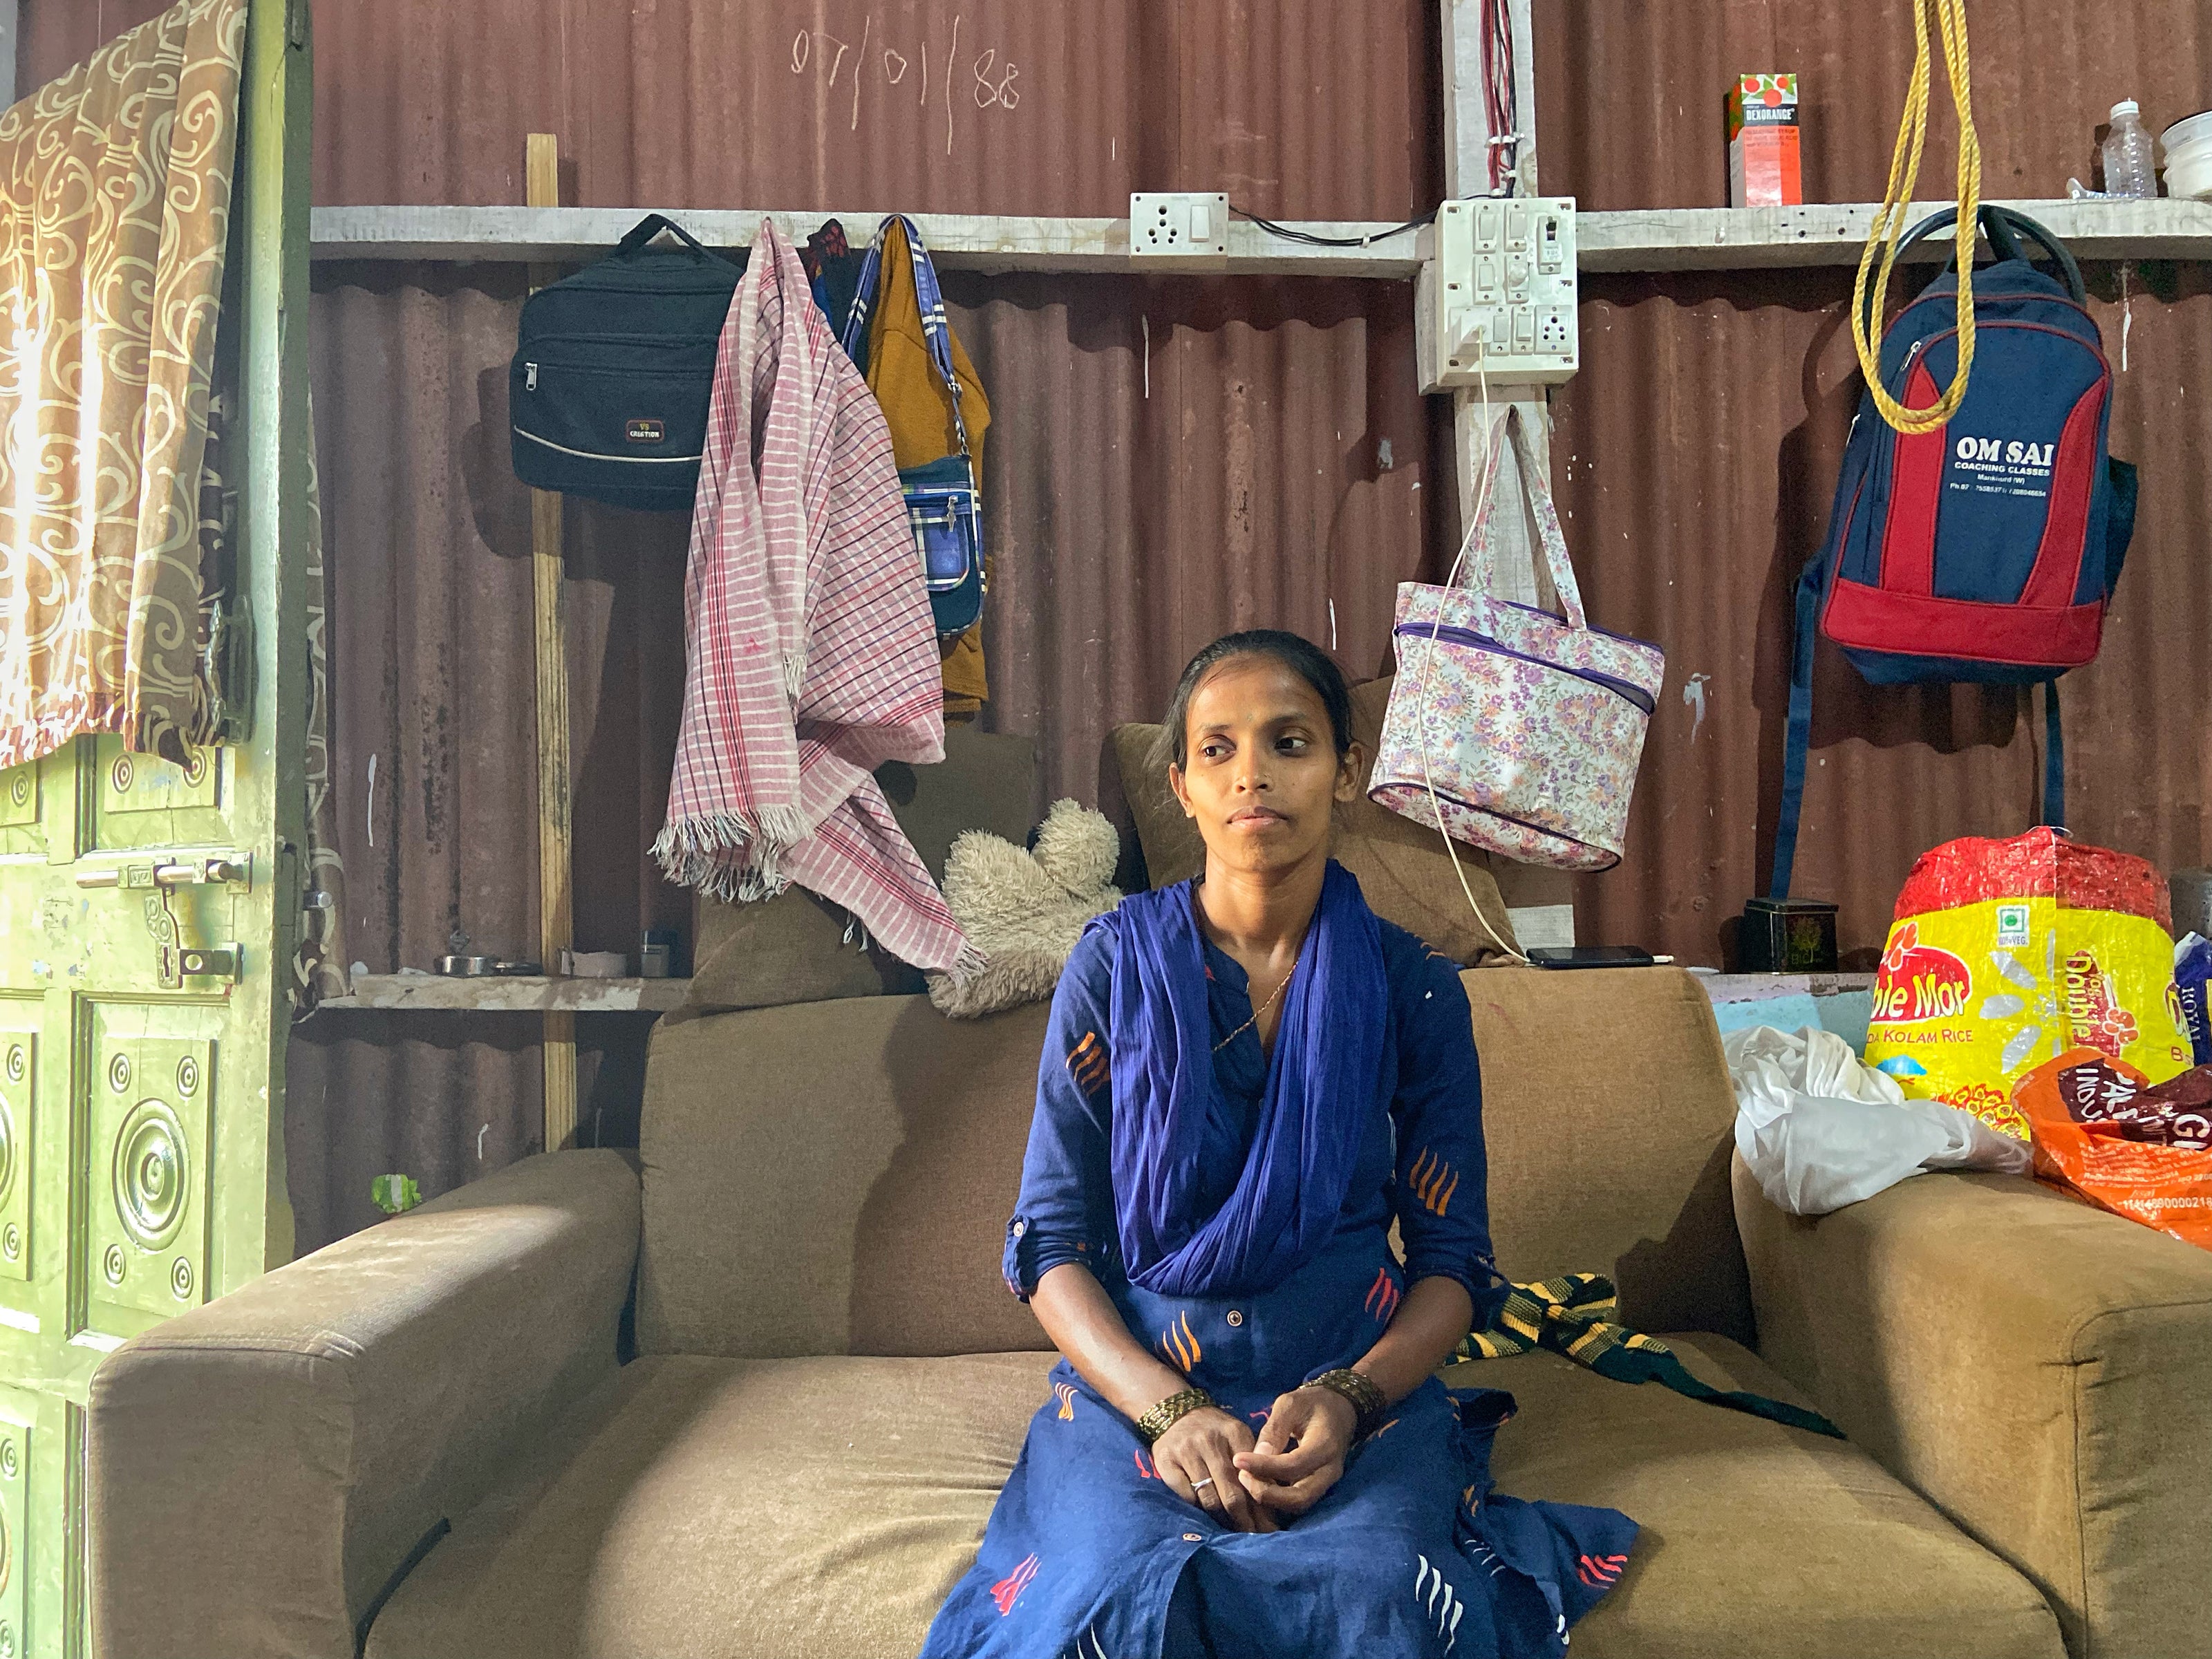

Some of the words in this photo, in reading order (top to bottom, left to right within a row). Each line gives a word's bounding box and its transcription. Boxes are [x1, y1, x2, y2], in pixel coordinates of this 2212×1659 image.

[1956, 437, 2002, 462] OM
[2005, 441, 2054, 467] SAI
[1954, 461, 2005, 473] COACHING
[2007, 466, 2050, 476] CLASSES
[2065, 955, 2101, 1038] Double
[1883, 1029, 1938, 1044] KOLAM
[1941, 1029, 1974, 1043] RICE
[2076, 1068, 2108, 1123] INDU
